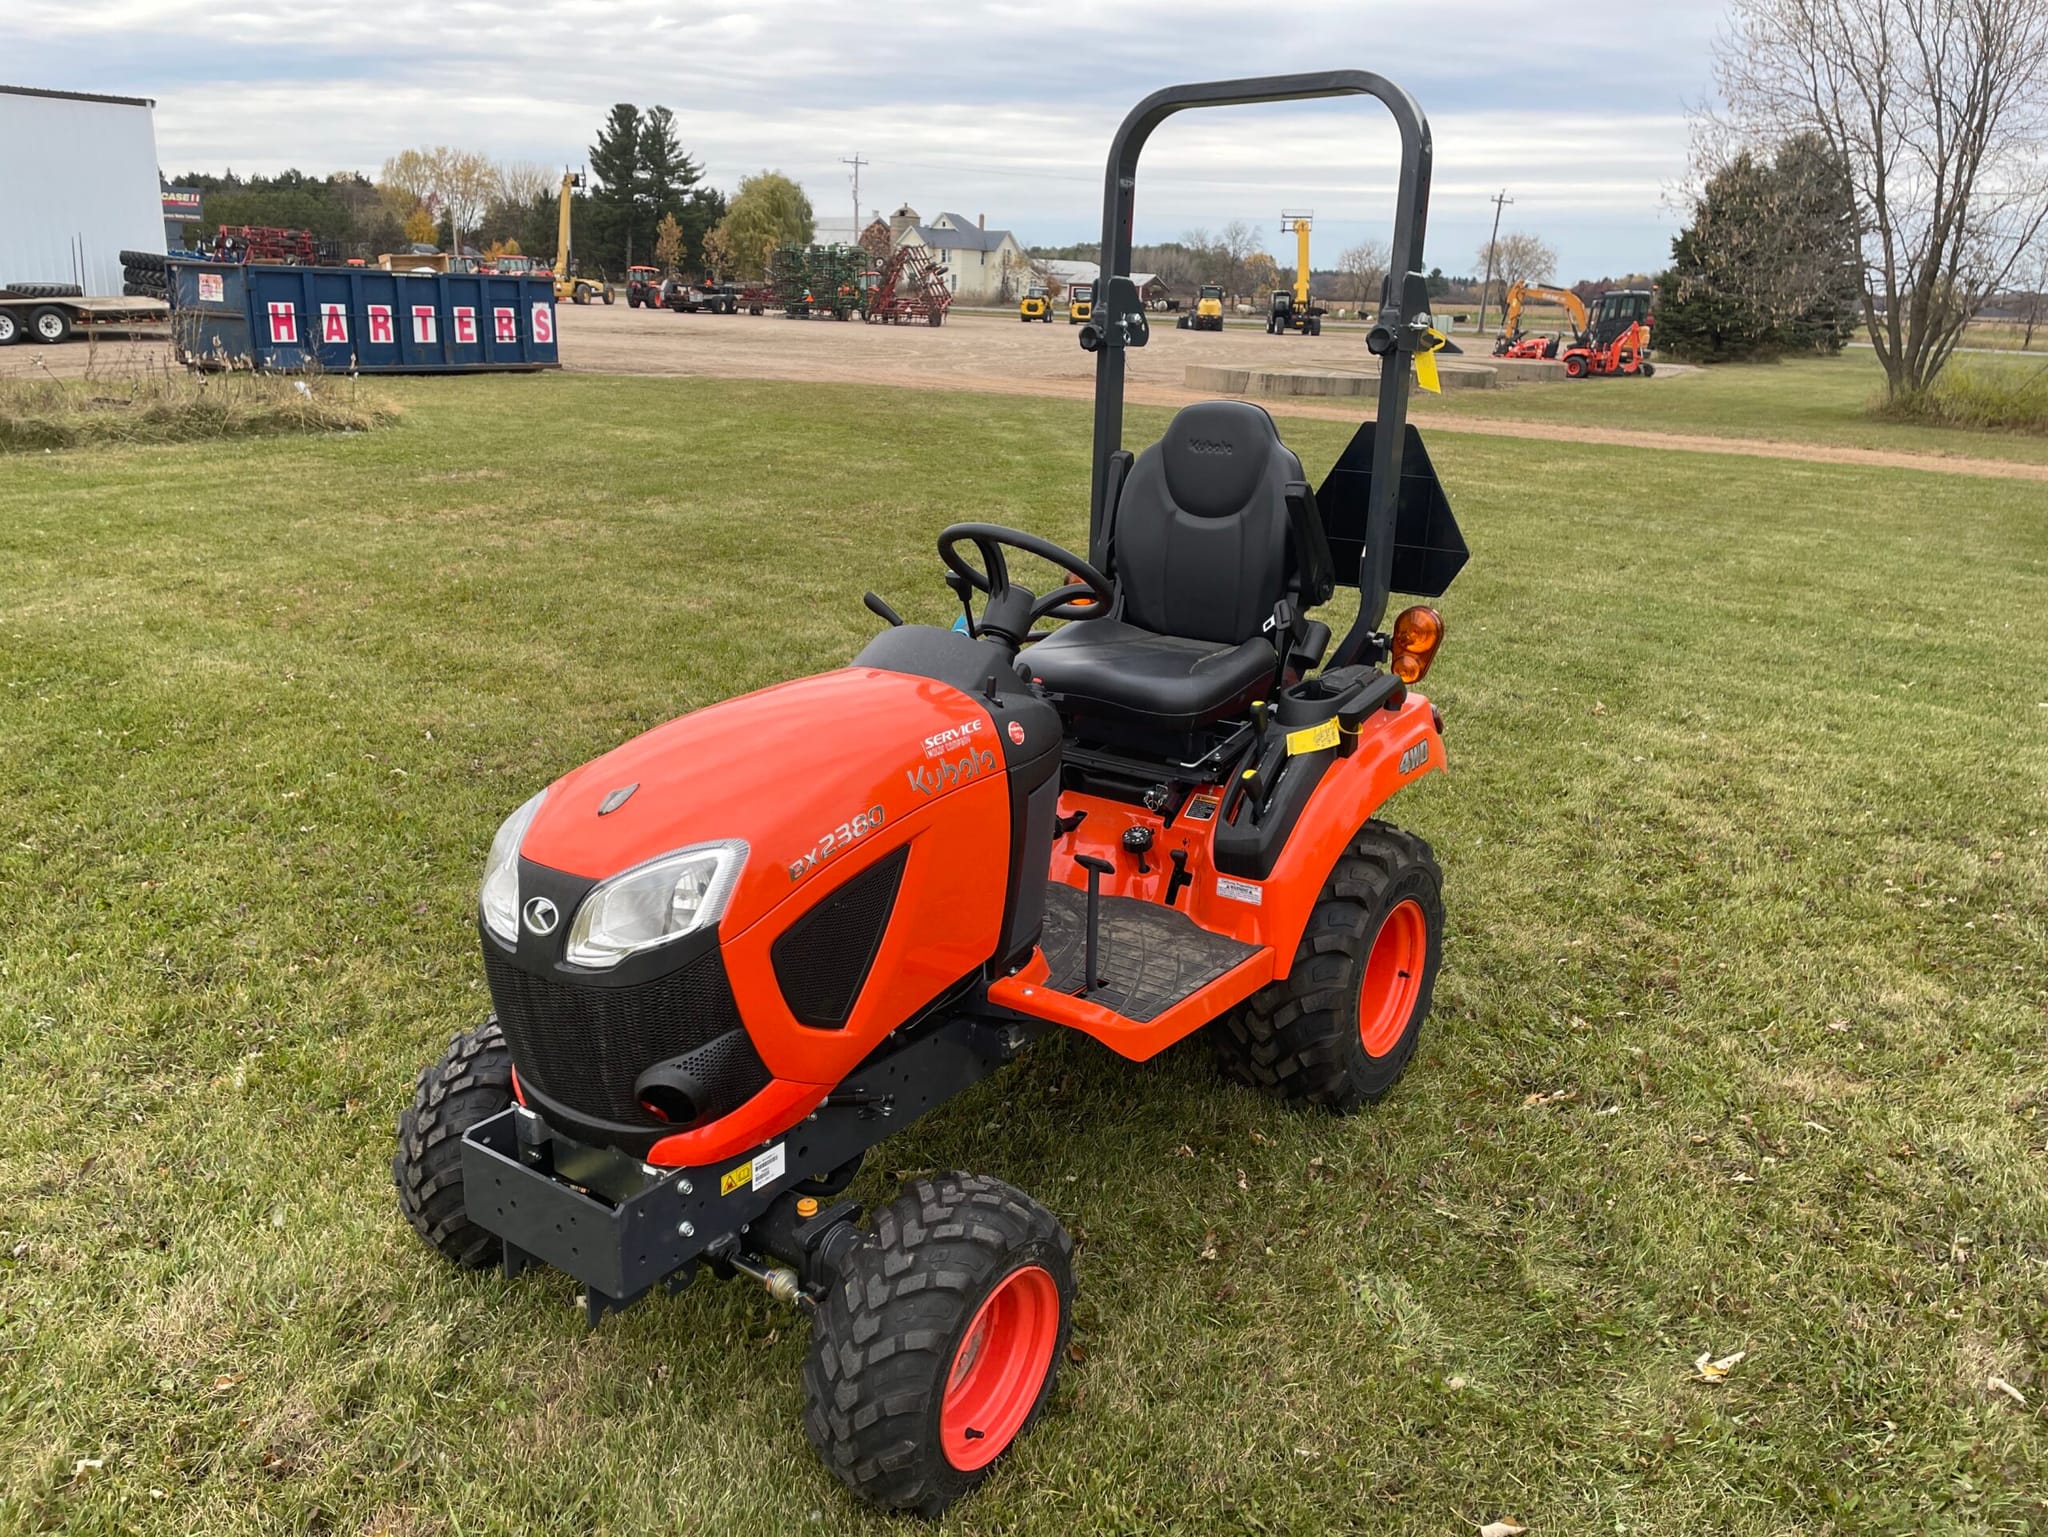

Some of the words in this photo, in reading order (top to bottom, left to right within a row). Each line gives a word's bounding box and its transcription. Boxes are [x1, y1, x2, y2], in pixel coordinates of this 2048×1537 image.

[161, 192, 190, 202] CASE
[271, 303, 552, 341] HARTERS
[1189, 439, 1232, 455] Kubota
[924, 719, 982, 750] SERVICE
[906, 746, 997, 795] Kubota
[1399, 739, 1428, 774] 4WD
[788, 804, 885, 882] BX2380
